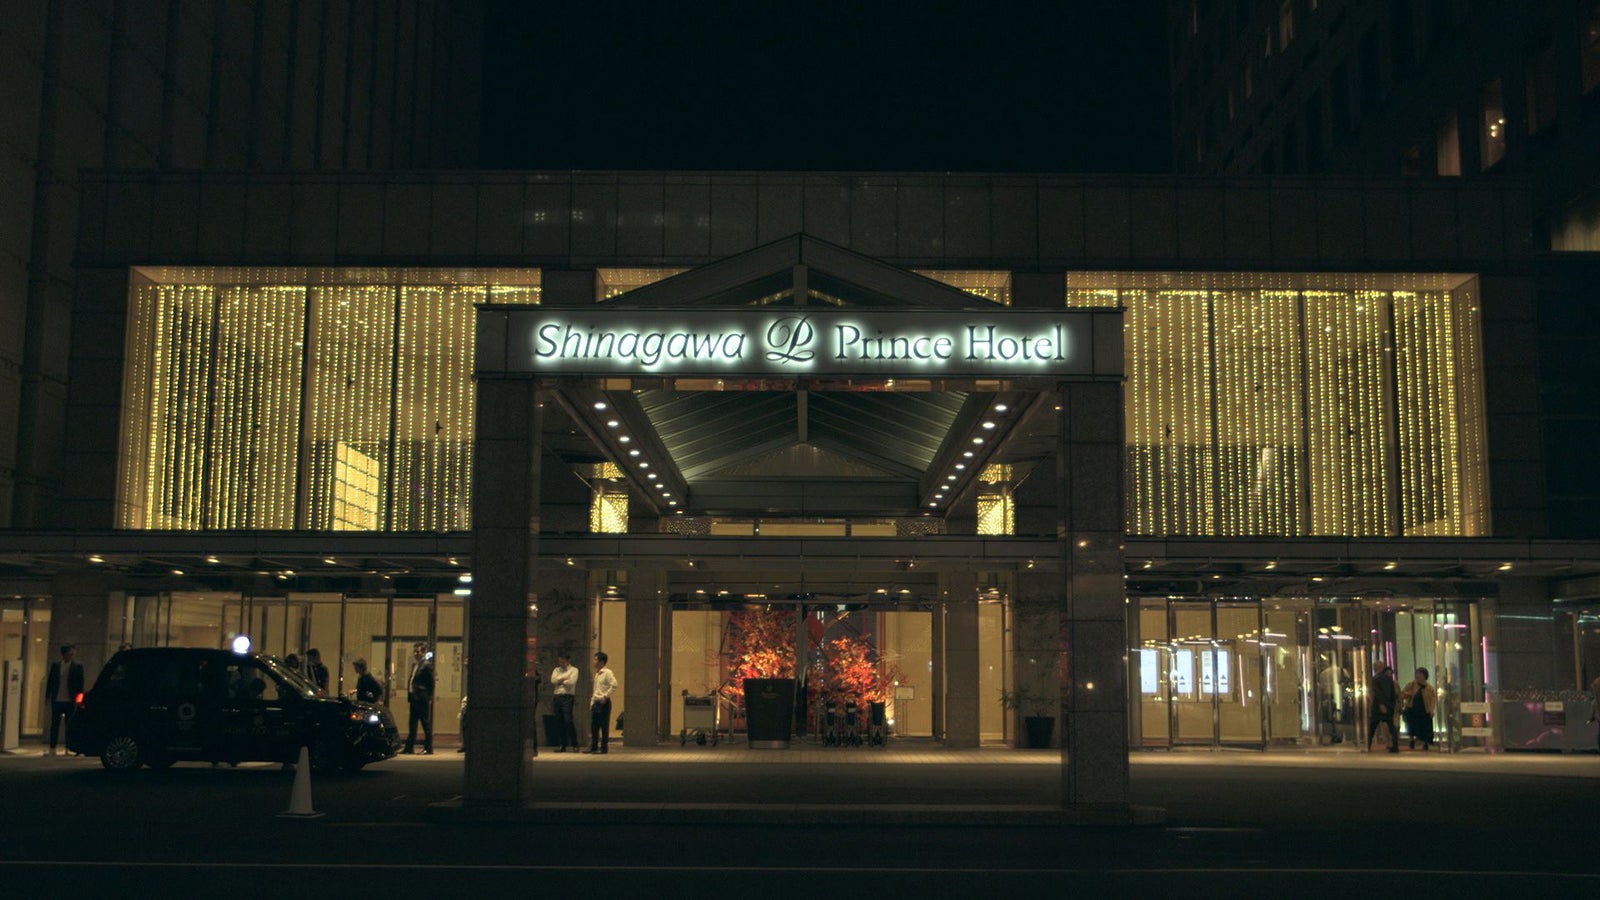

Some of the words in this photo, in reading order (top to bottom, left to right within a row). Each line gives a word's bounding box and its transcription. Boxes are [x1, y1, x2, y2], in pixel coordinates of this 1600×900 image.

[534, 324, 747, 367] Shinagawa
[834, 324, 953, 362] Prince
[965, 323, 1066, 362] Hotel
